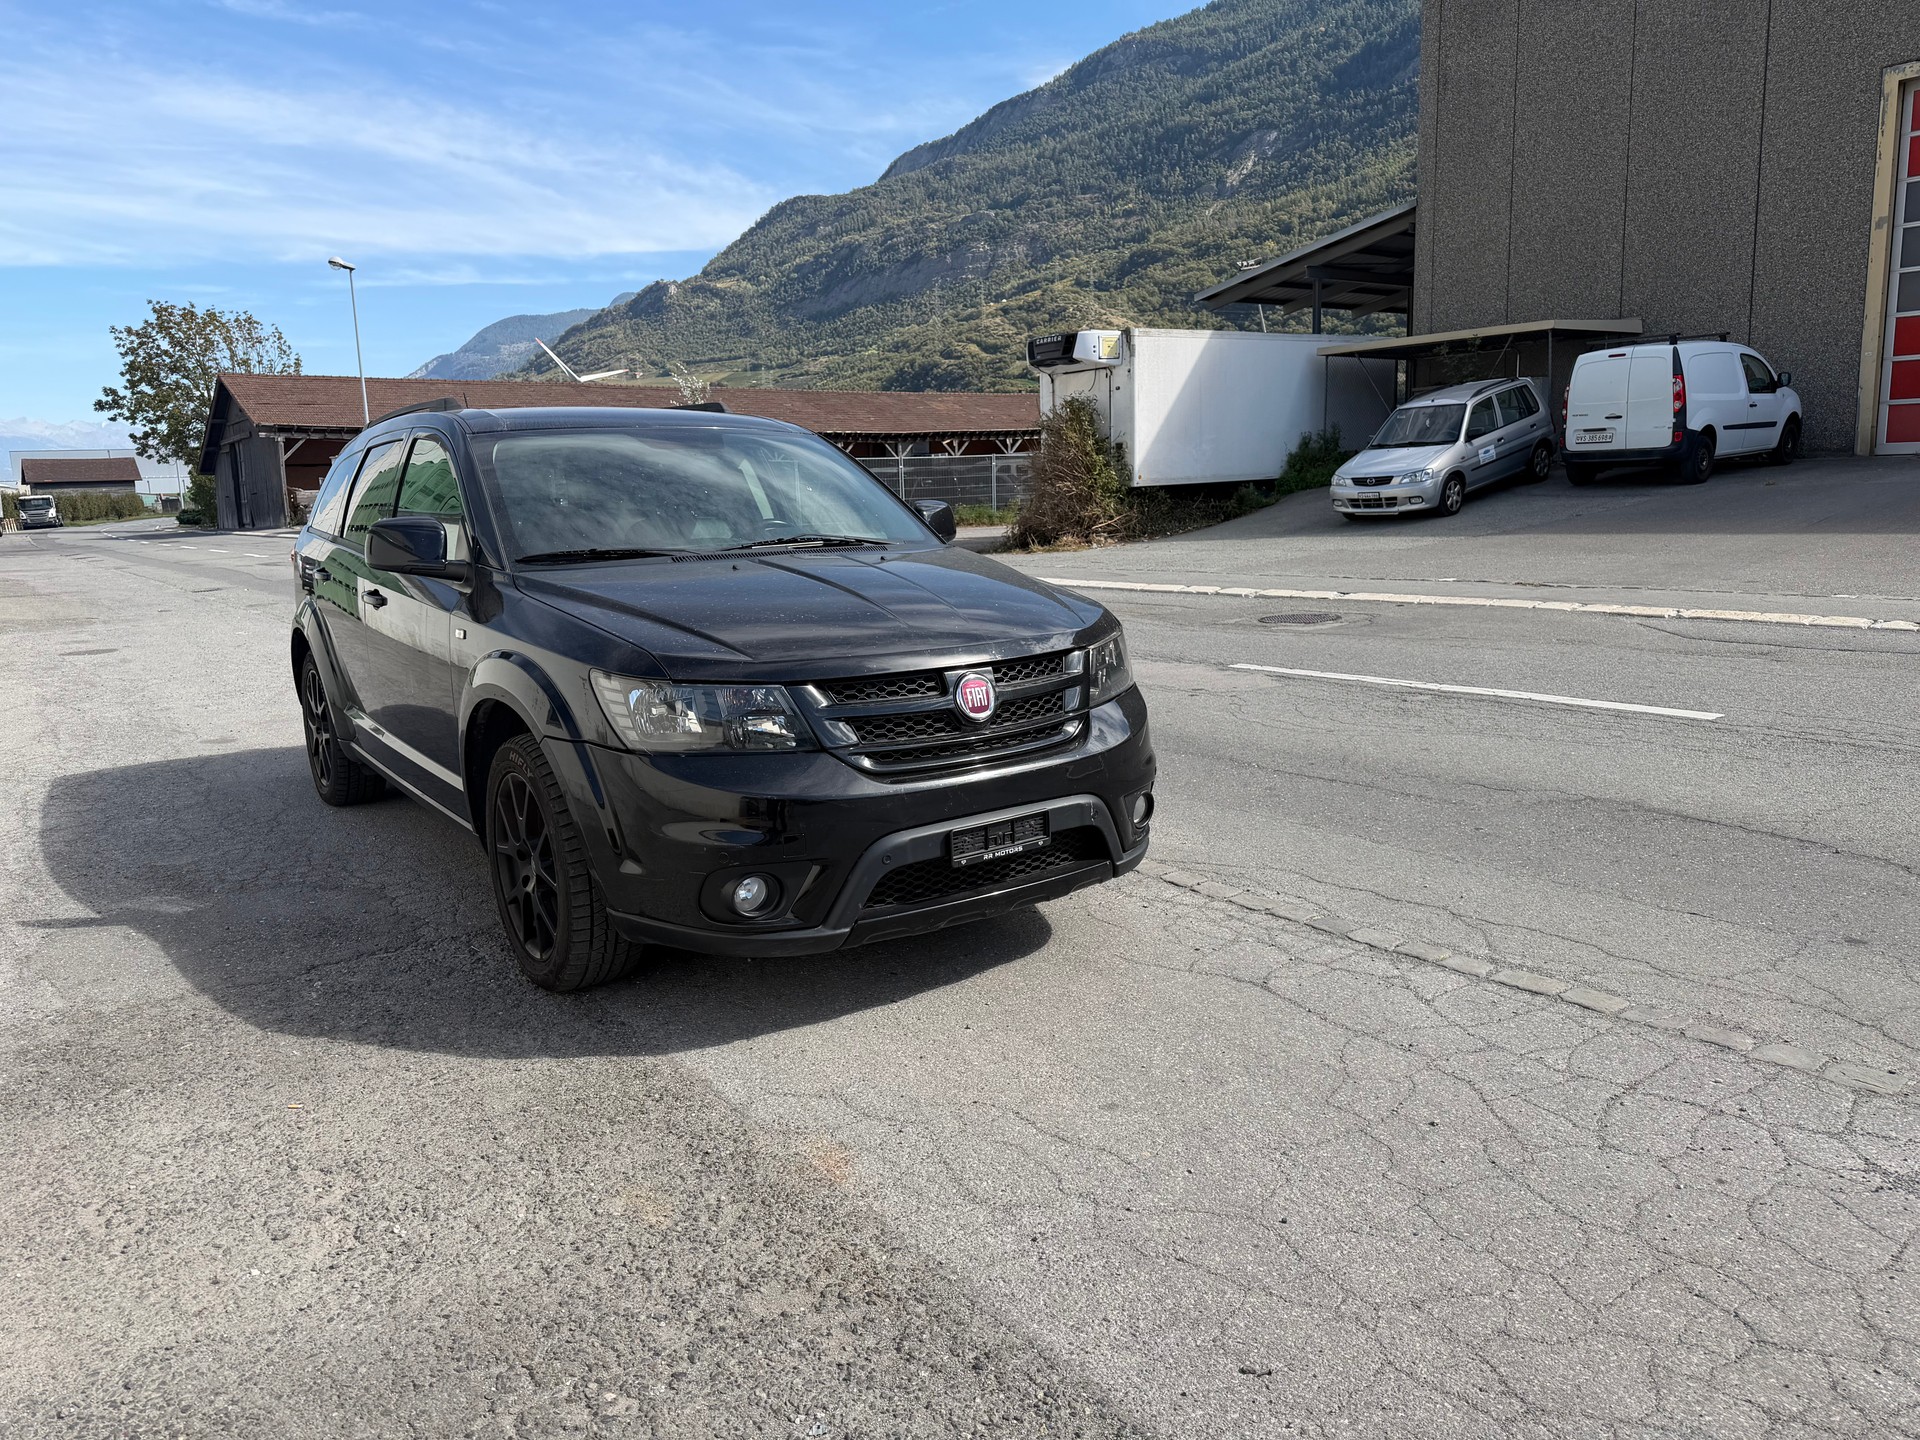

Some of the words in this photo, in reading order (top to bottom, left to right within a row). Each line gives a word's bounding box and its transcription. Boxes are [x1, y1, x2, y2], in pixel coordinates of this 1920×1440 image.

[1036, 335, 1062, 345] CARRIER
[966, 686, 988, 708] FIAT
[509, 750, 534, 778] HIFLY
[994, 845, 1023, 857] MOTORS
